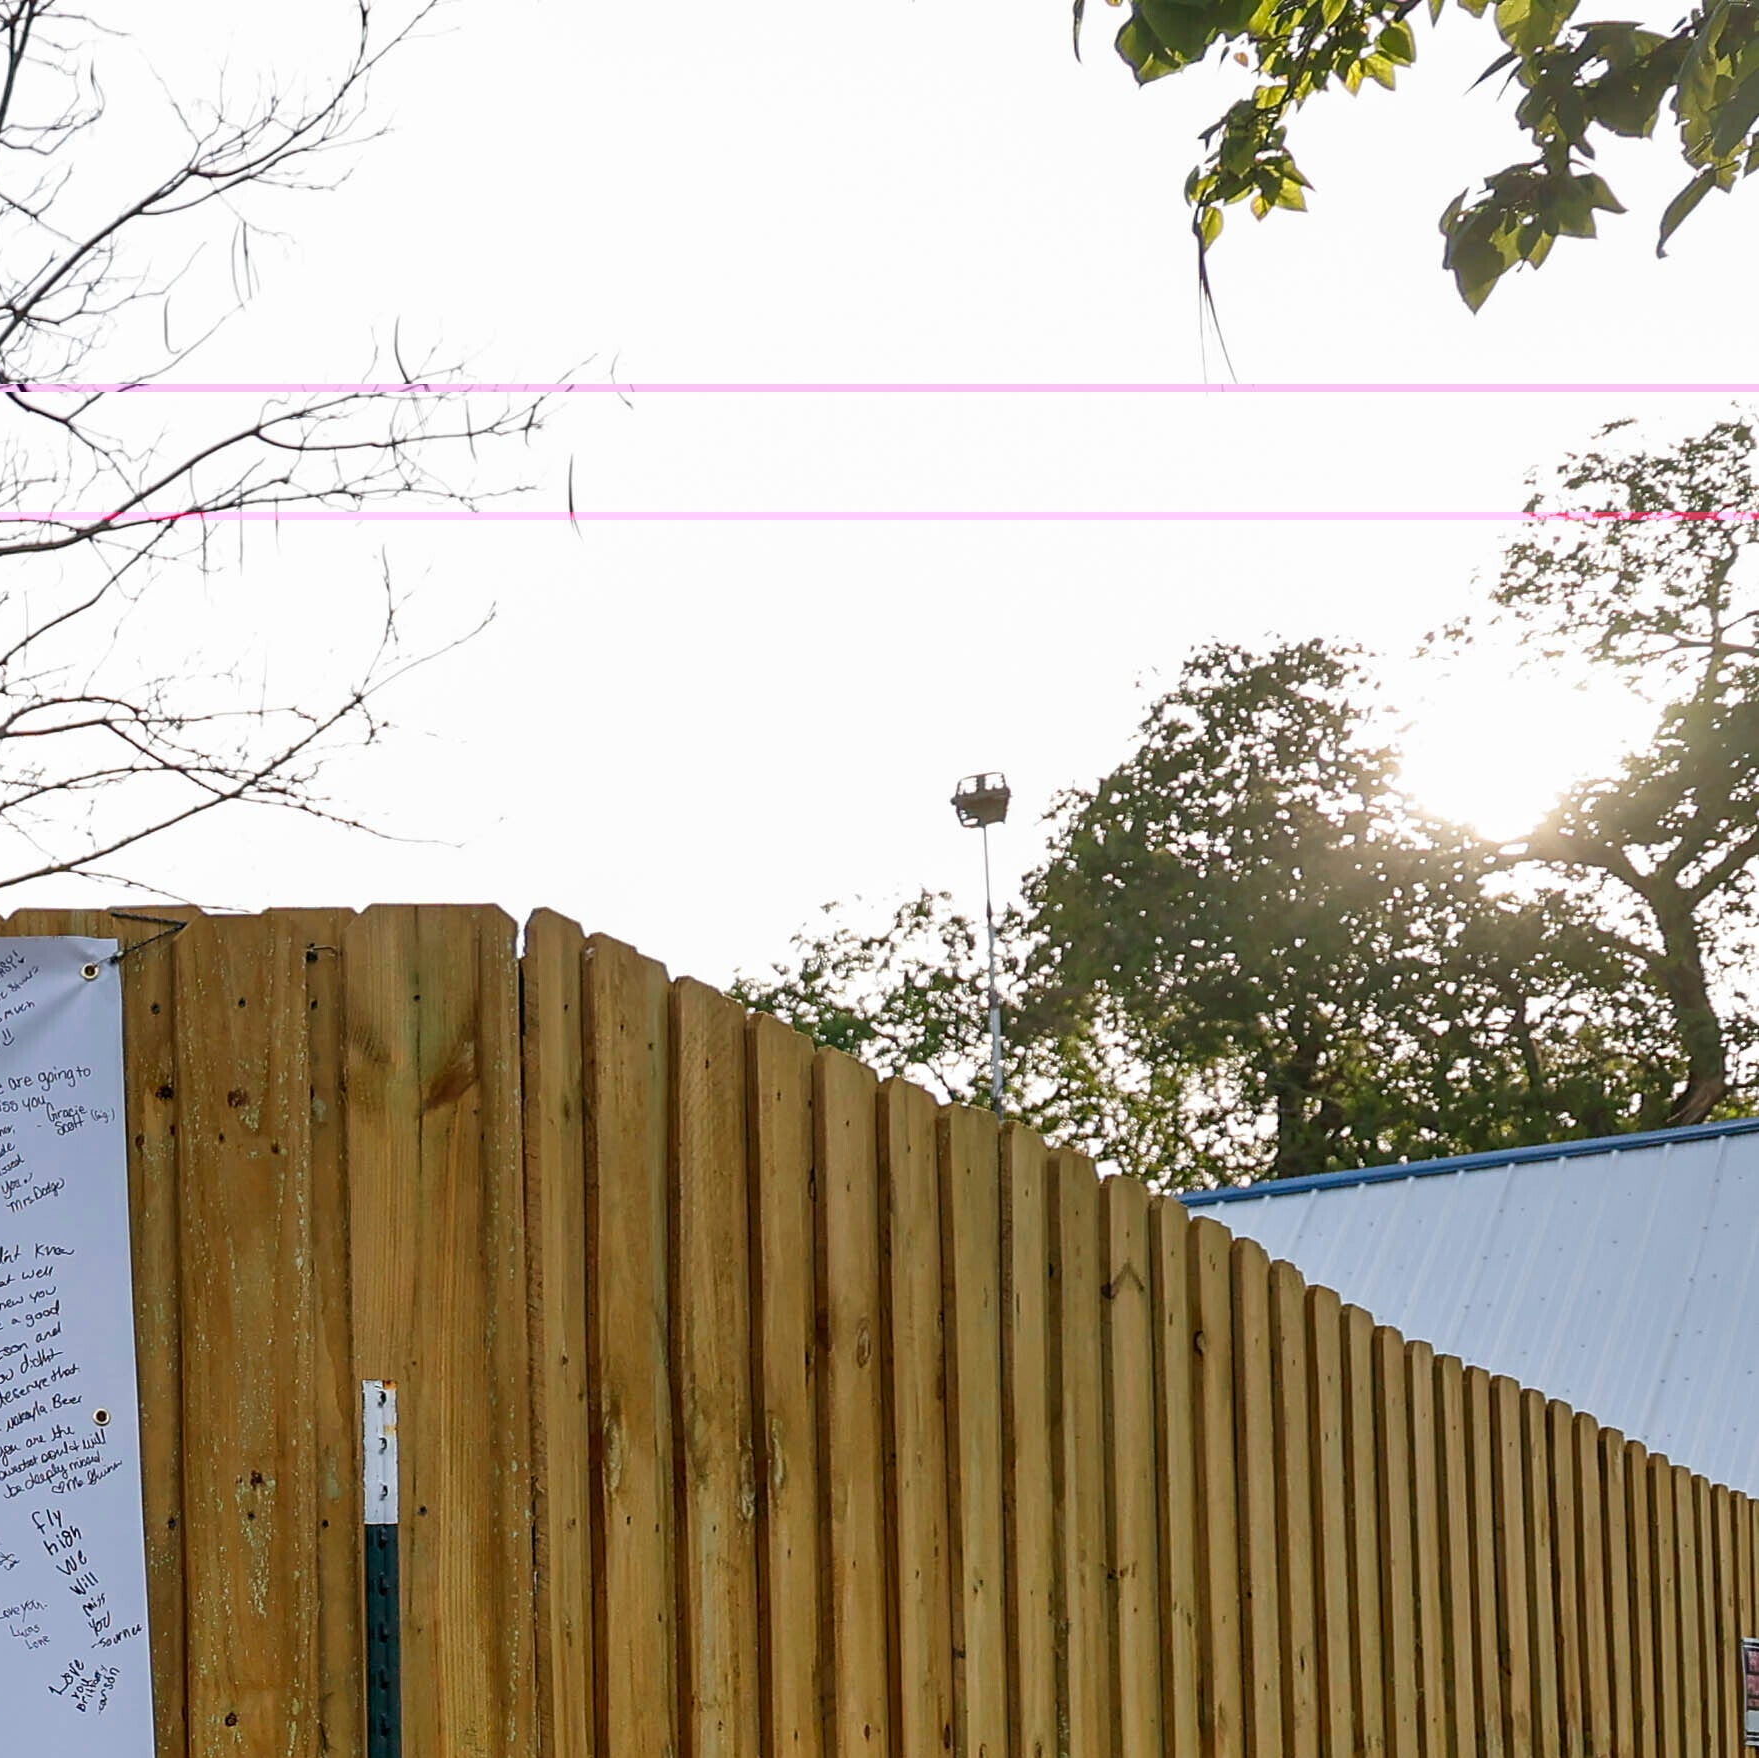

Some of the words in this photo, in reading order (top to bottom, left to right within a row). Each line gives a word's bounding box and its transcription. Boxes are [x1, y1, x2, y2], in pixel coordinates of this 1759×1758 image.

[8, 1076, 33, 1090] are
[38, 1066, 75, 1091] going
[76, 1066, 91, 1077] to
[22, 1095, 49, 1116] you
[29, 1286, 56, 1303] you
[25, 1299, 59, 1327] good
[36, 1321, 61, 1343] and
[51, 1363, 80, 1382] that
[26, 1435, 46, 1448] are
[51, 1424, 75, 1441] the
[43, 1525, 82, 1559] high
[83, 1593, 105, 1617] miss
